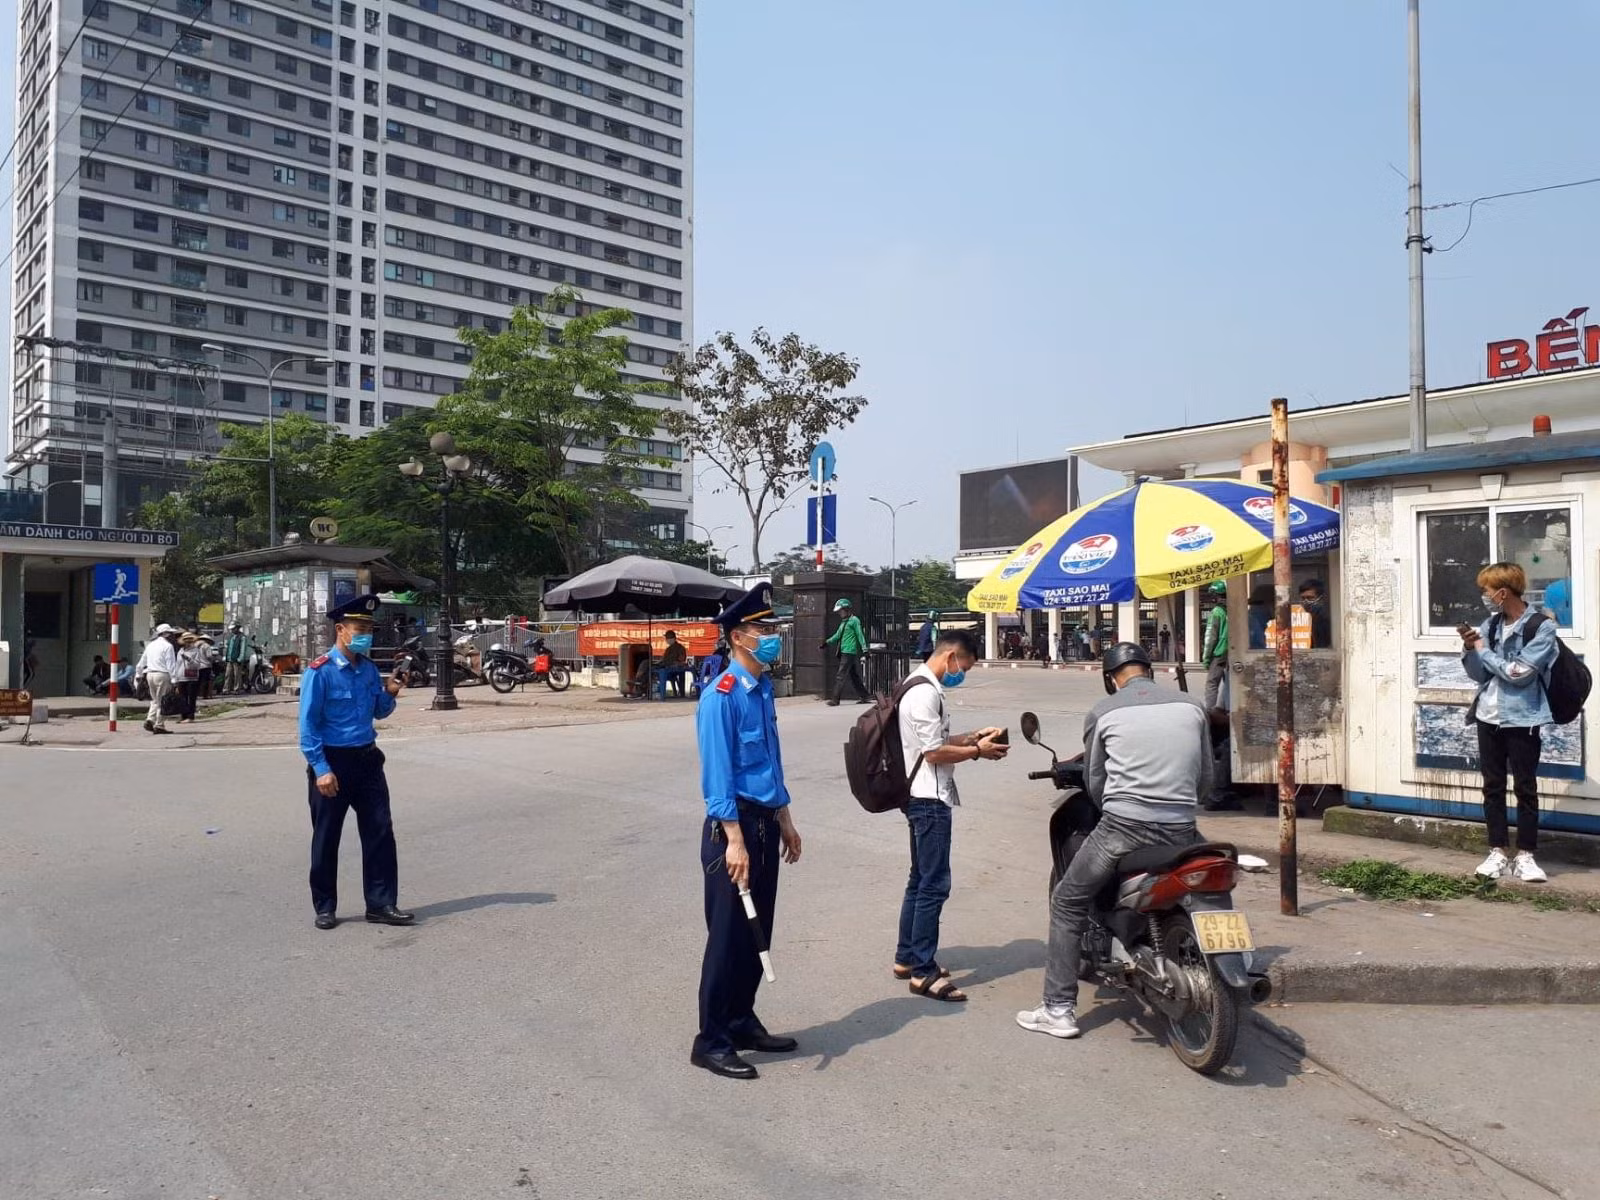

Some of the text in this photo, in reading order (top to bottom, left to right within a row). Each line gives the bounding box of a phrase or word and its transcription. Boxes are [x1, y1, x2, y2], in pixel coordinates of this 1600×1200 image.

[25, 525, 63, 539] DÀNH
[67, 529, 93, 541] CHO
[318, 523, 334, 533] WC
[1292, 537, 1308, 546] TAXI
[1308, 532, 1325, 542] SAO
[1168, 554, 1244, 580] TAXI SAO MAI
[1169, 563, 1245, 589] 024.38.27.27.27
[1044, 584, 1110, 598] TAXI SAO MAI
[1205, 932, 1246, 949] 6796
